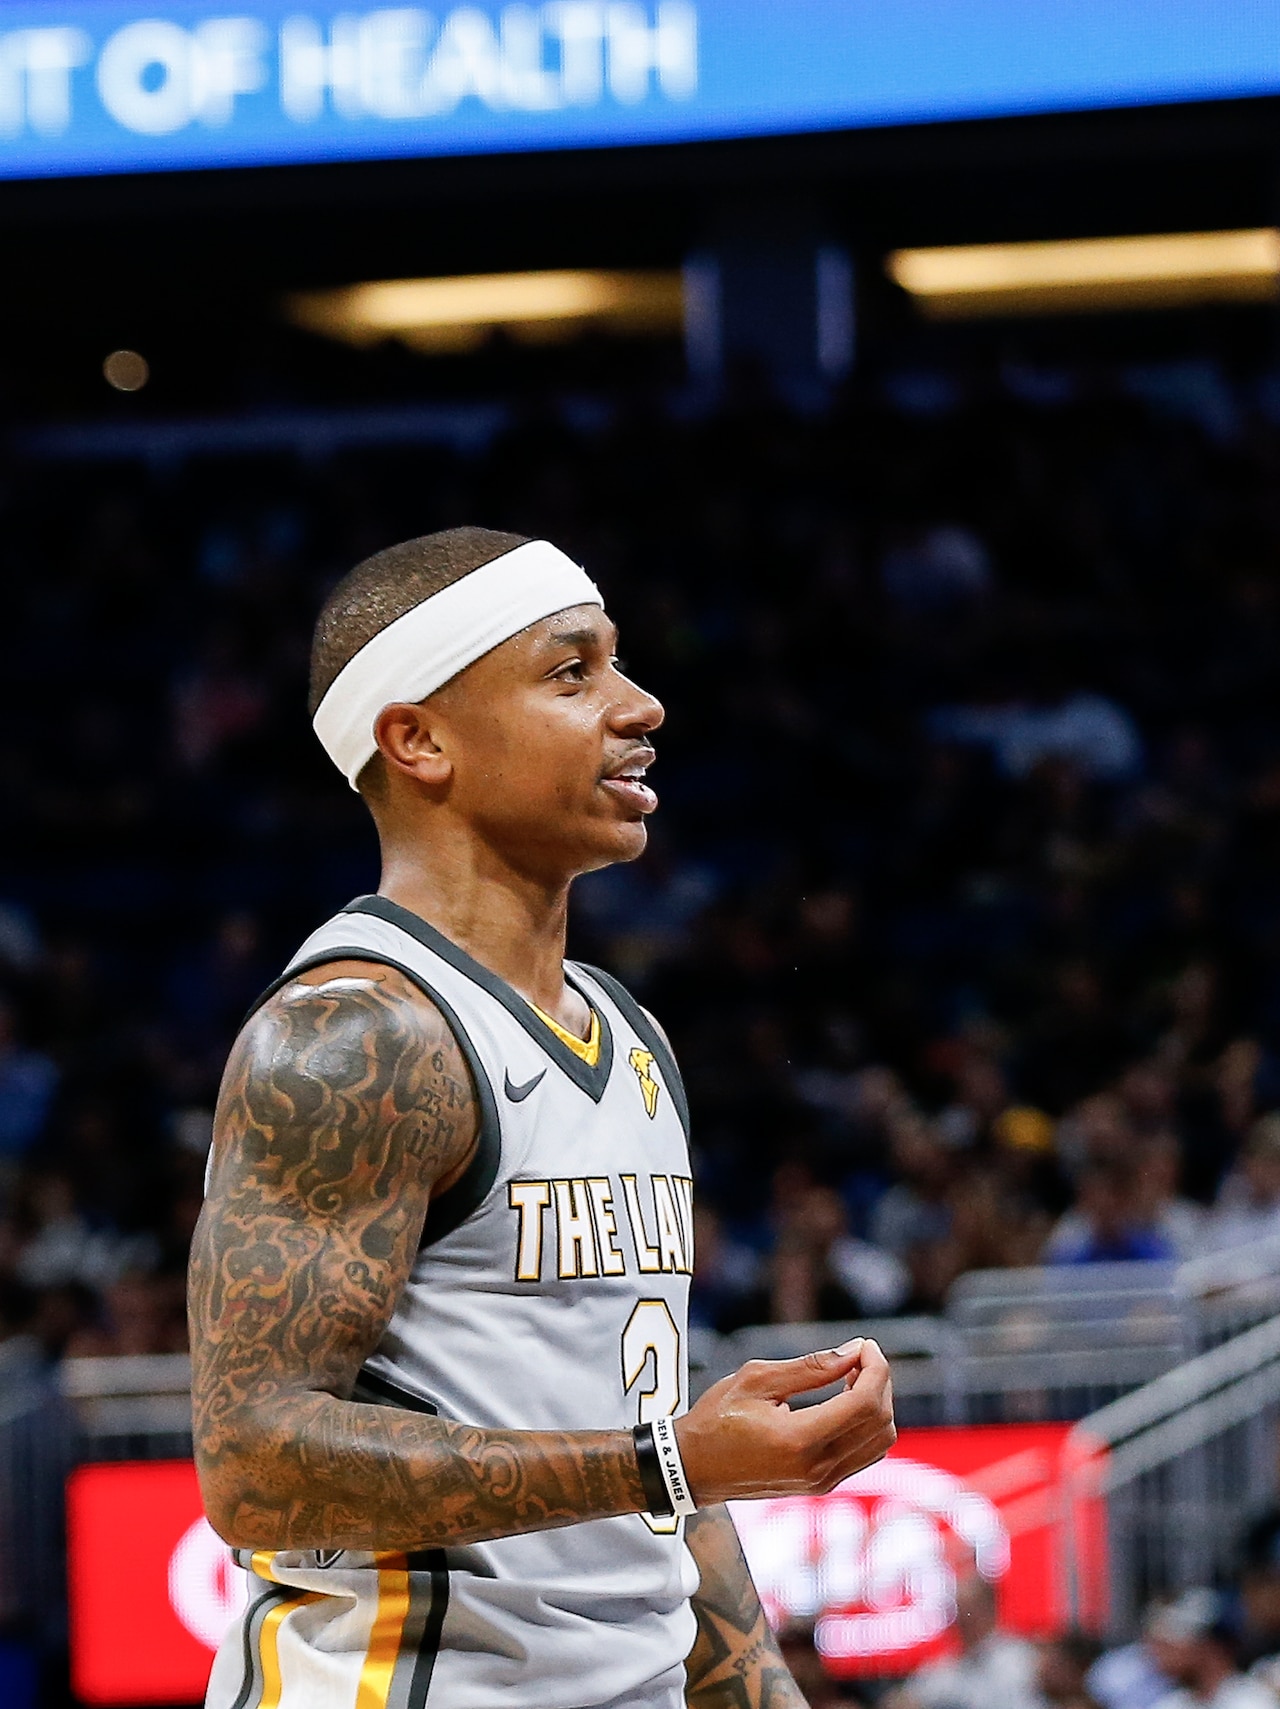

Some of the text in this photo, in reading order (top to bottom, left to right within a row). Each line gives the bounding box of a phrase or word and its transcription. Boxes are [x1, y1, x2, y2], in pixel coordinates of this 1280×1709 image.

[98, 17, 268, 136] OF
[280, 1, 698, 124] HEALTH
[508, 1176, 626, 1282] THE
[621, 1298, 680, 1535] 3
[662, 1446, 672, 1456] &
[666, 1460, 686, 1501] JAMES
